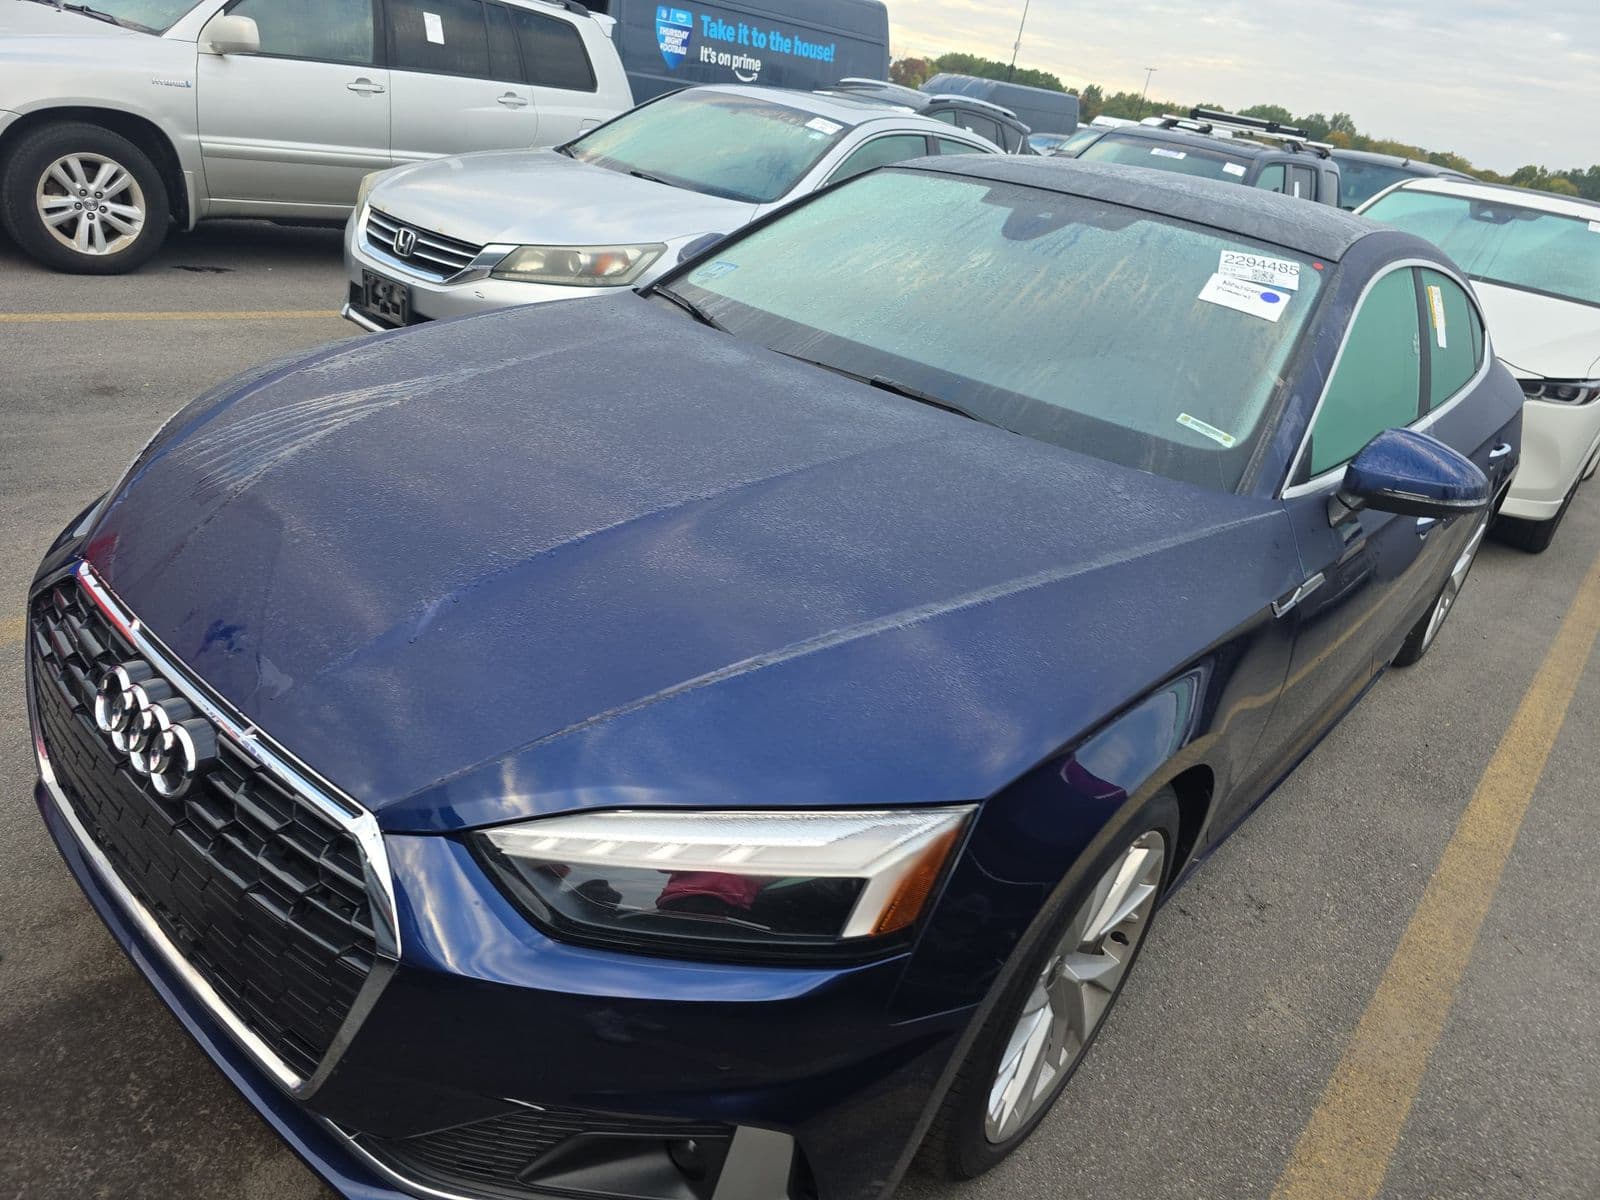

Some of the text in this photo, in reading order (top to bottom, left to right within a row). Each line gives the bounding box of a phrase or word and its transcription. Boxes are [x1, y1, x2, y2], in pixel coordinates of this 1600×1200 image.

[701, 15, 835, 62] Take it to the house!
[700, 45, 761, 71] It's on prime
[1223, 254, 1300, 276] 2294485
